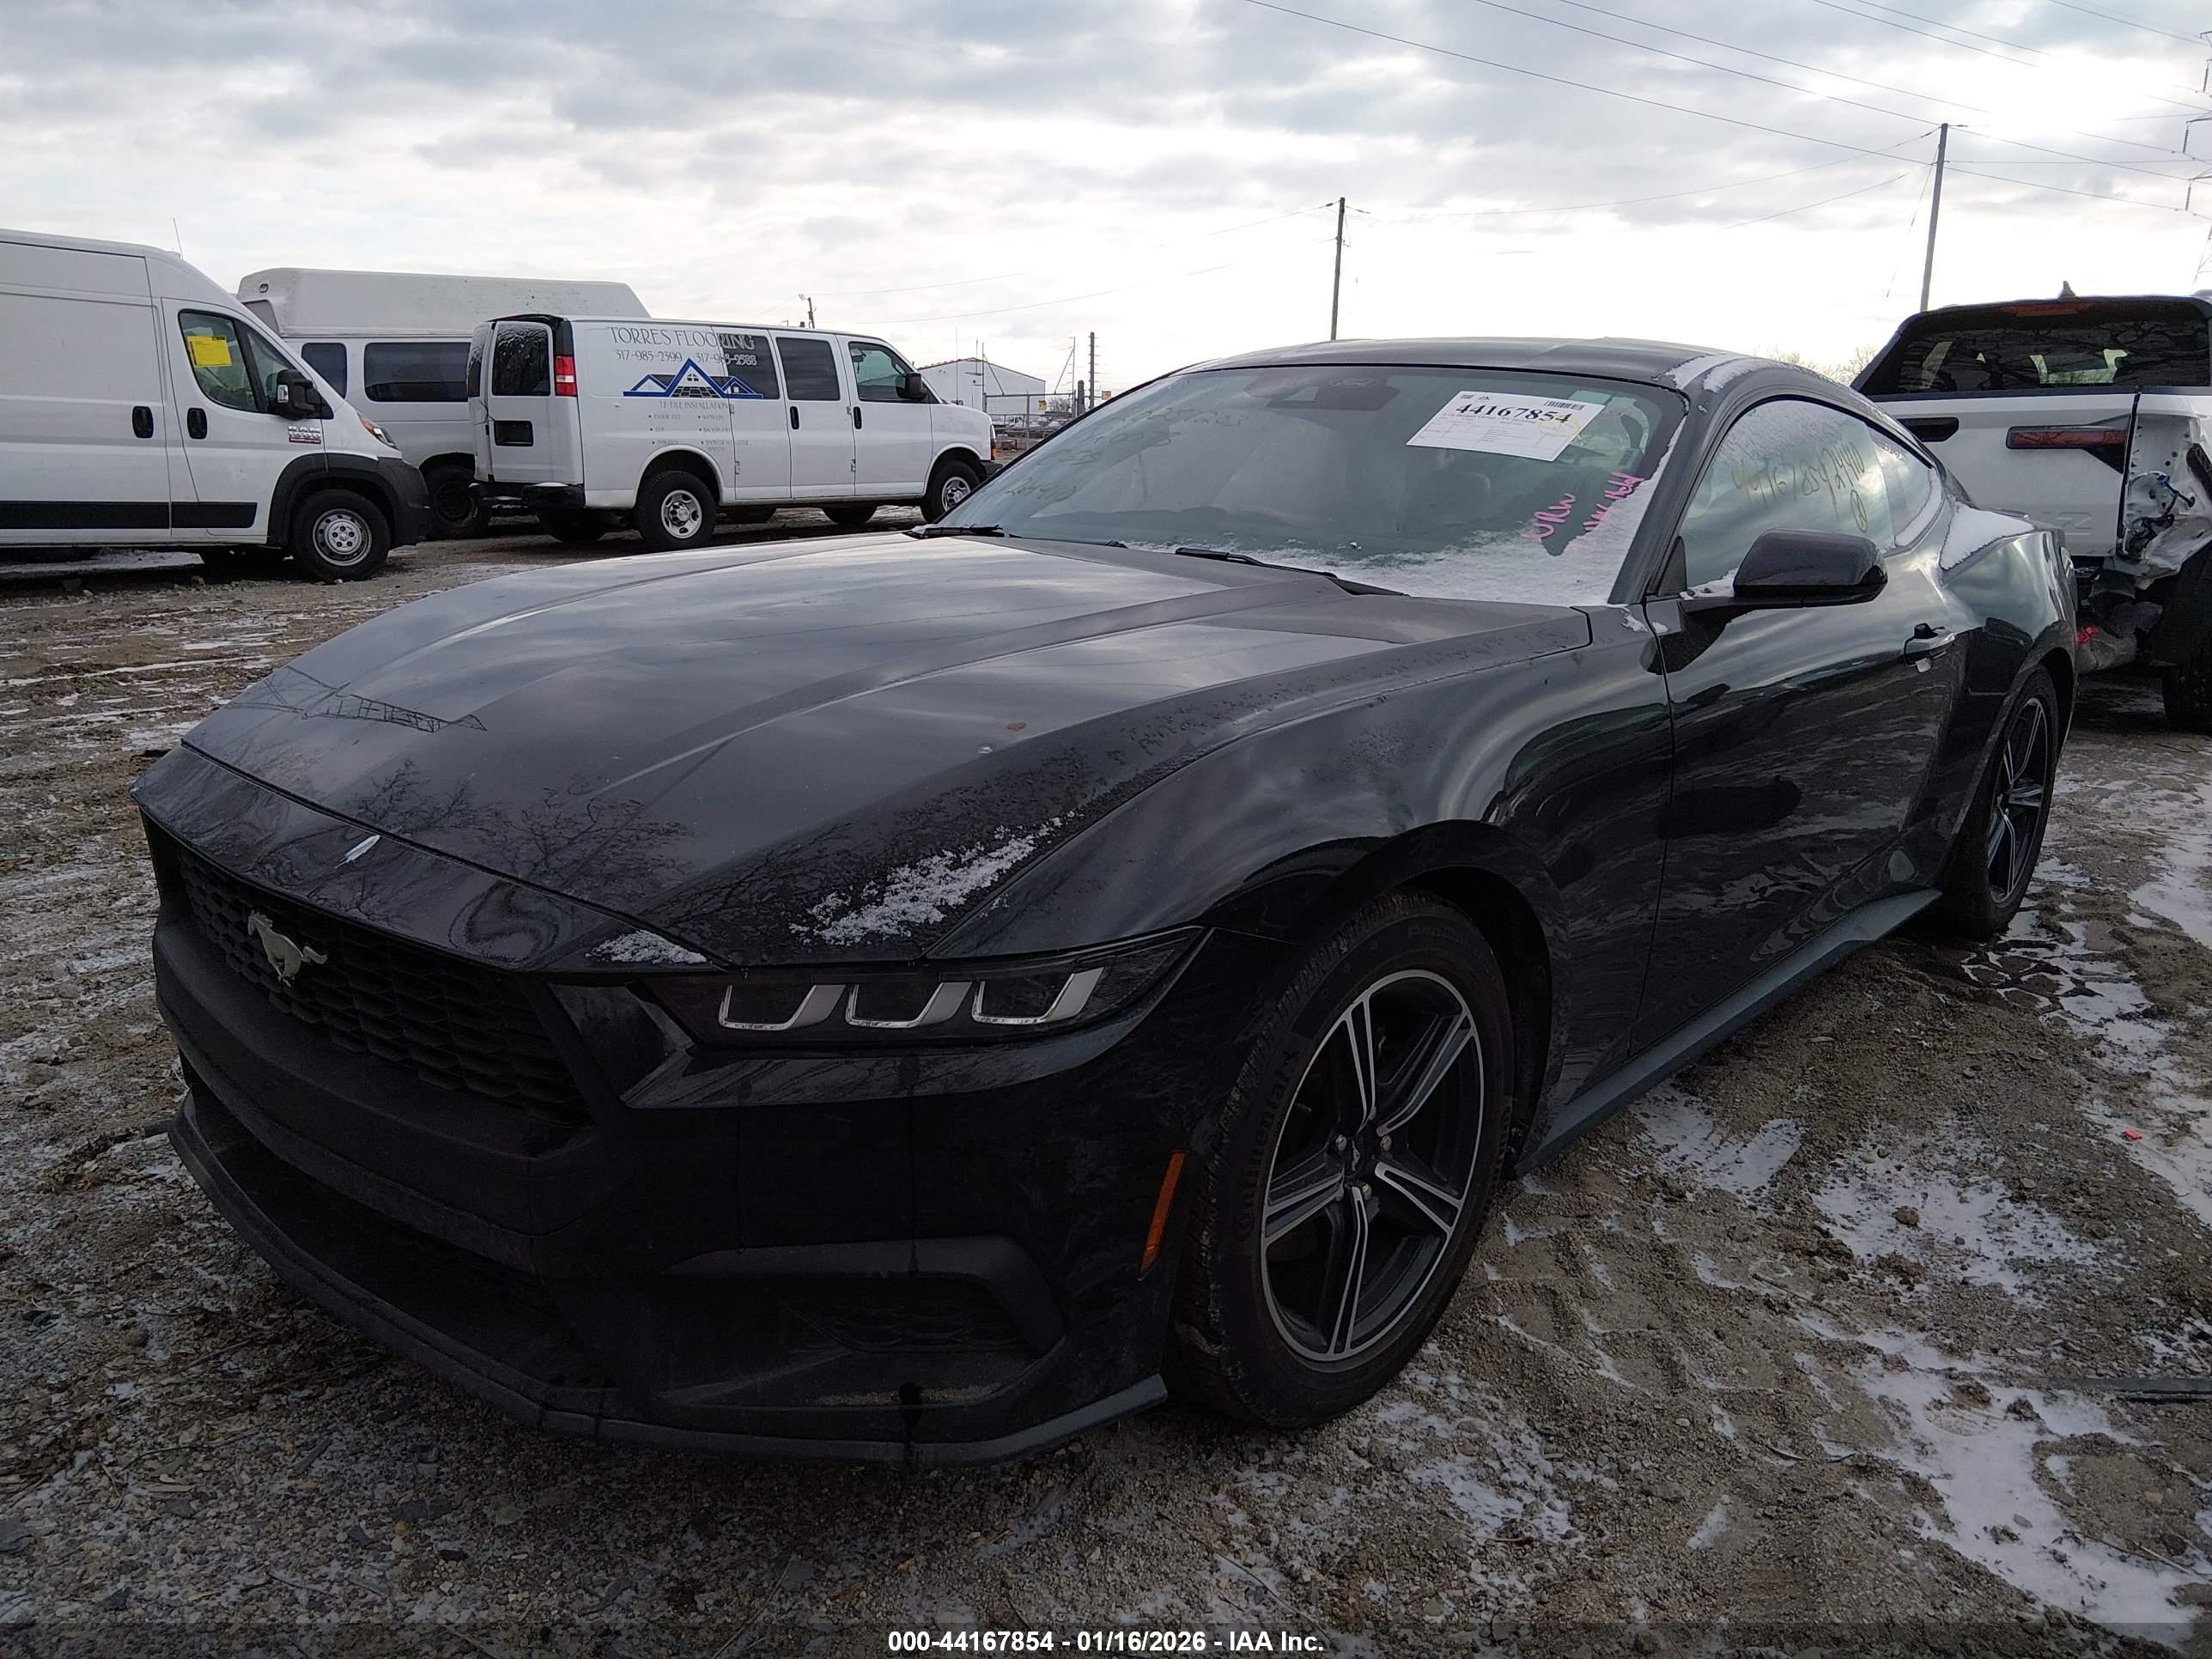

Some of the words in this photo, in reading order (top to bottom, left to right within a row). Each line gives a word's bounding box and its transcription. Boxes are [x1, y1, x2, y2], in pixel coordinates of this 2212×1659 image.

[611, 327, 672, 346] TORRES
[674, 330, 756, 350] FLOORING
[1455, 403, 1573, 423] 44167854
